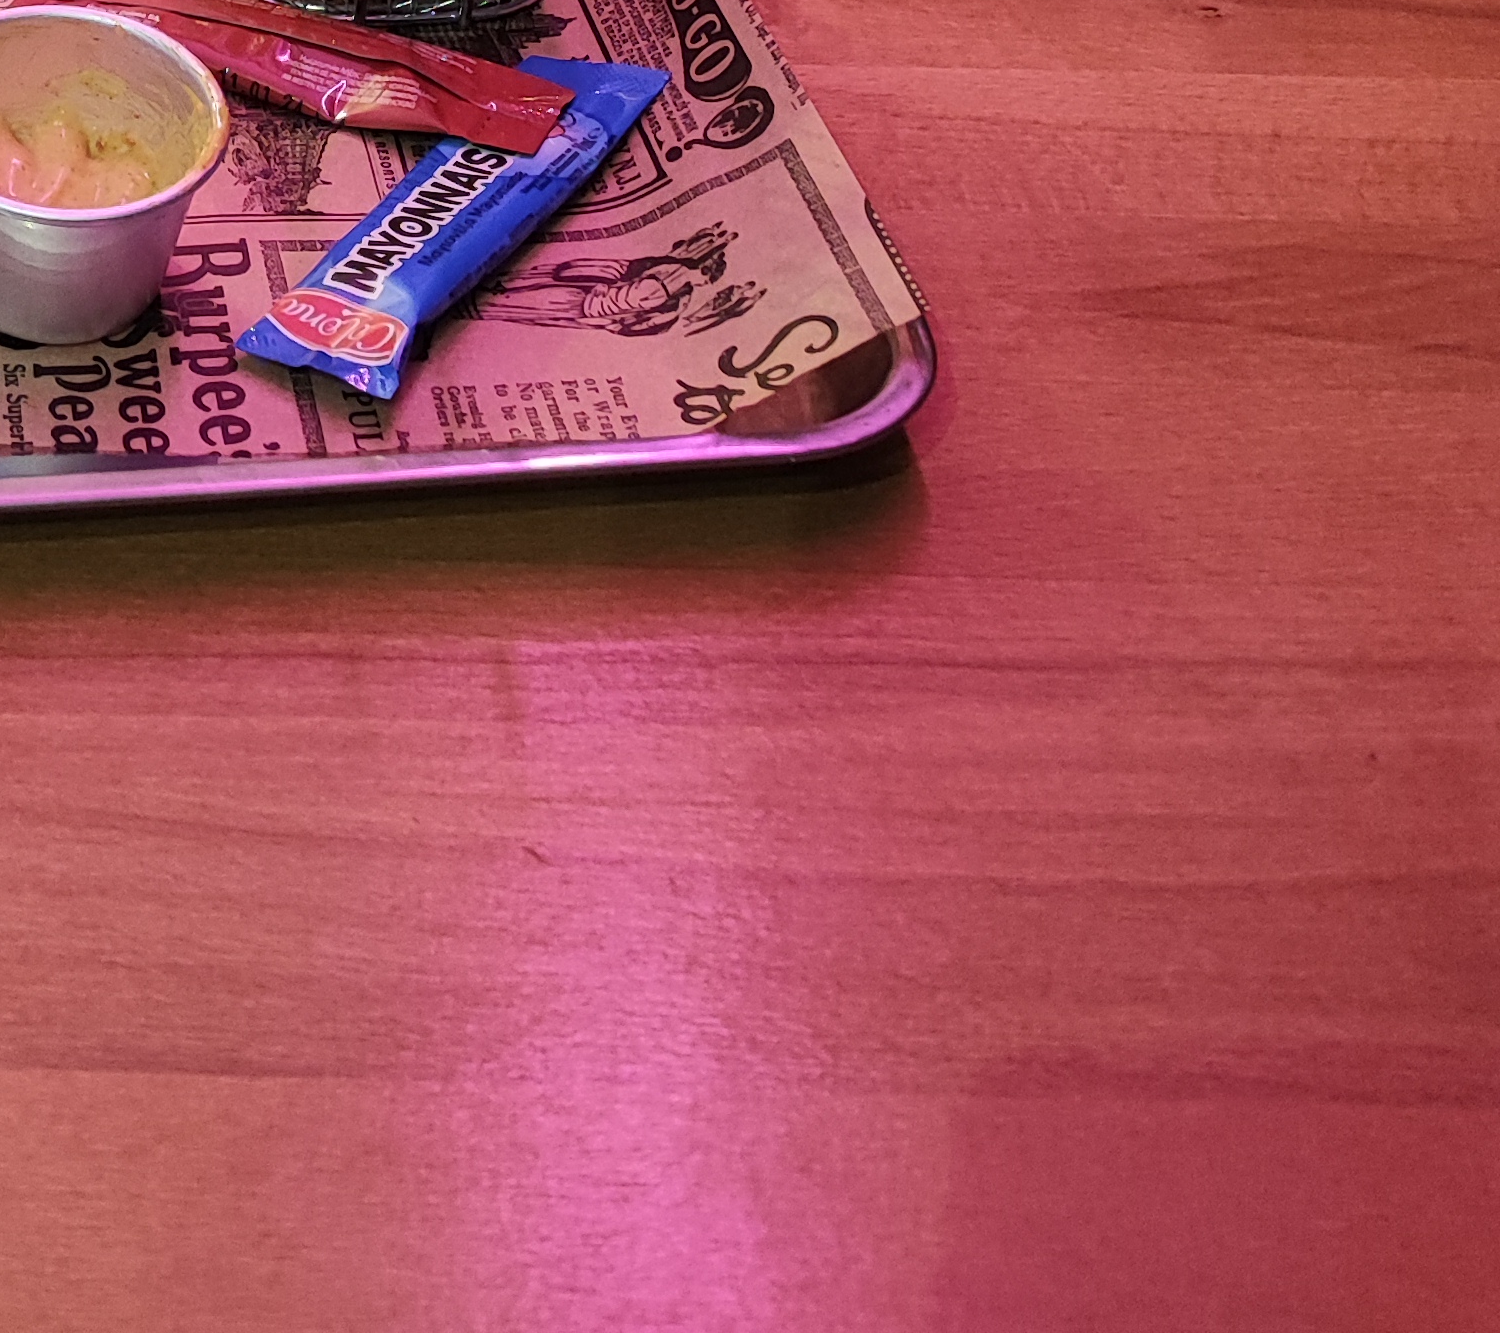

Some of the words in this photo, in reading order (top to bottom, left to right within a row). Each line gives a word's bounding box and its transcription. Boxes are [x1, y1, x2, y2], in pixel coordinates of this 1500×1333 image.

[3, 363, 26, 388] Six
[583, 377, 599, 393] or
[493, 383, 512, 398] to
[515, 382, 536, 402] No
[605, 376, 629, 408] Your
[430, 385, 457, 428] Orders
[500, 405, 518, 421] be
[560, 379, 580, 402] For
[572, 410, 591, 432] the
